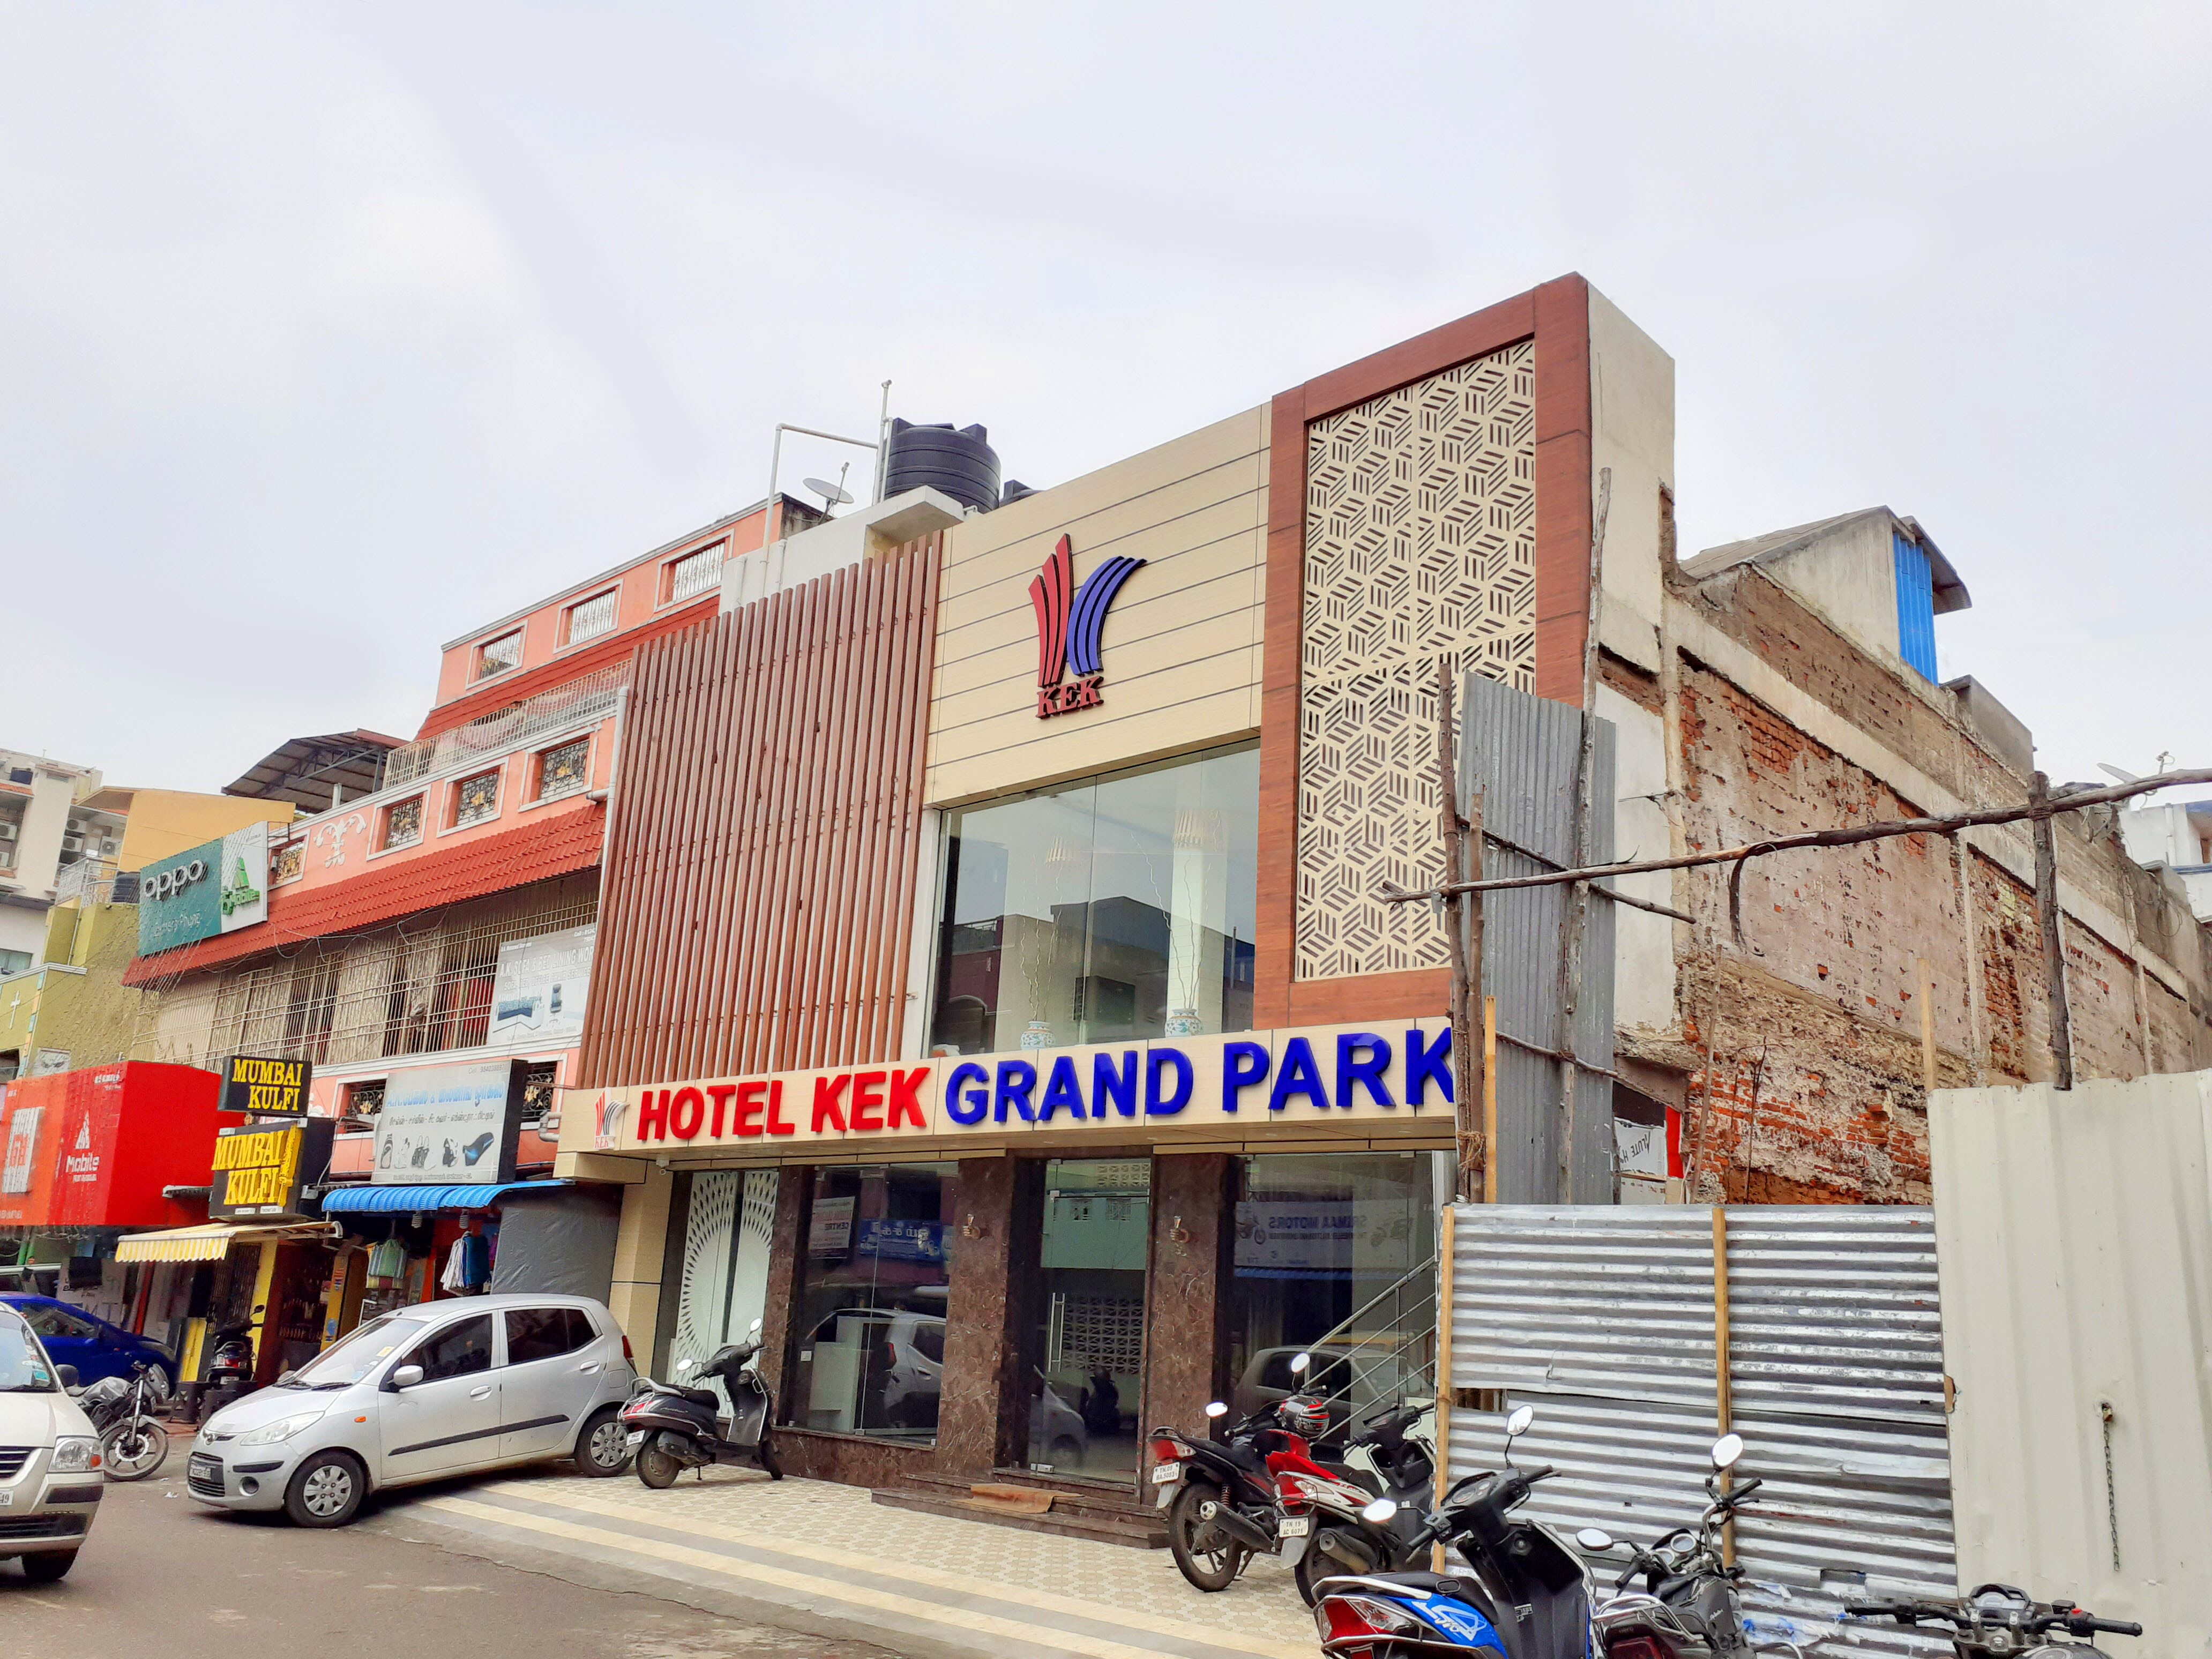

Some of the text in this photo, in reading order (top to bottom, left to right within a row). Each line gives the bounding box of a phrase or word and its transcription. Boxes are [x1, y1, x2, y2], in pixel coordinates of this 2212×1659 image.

[1035, 676, 1104, 719] KEK
[513, 958, 530, 976] SOFA
[552, 948, 577, 969] LINING
[231, 1058, 304, 1086] MUMBAI
[945, 1027, 1454, 1126] GRAND PARK
[248, 1085, 301, 1111] KULFI
[637, 1066, 931, 1141] HOTEL KEK
[211, 1130, 287, 1170] MUMBAI
[594, 1135, 610, 1149] KEK
[65, 1153, 100, 1173] Mobile
[223, 1167, 281, 1205] KULFI
